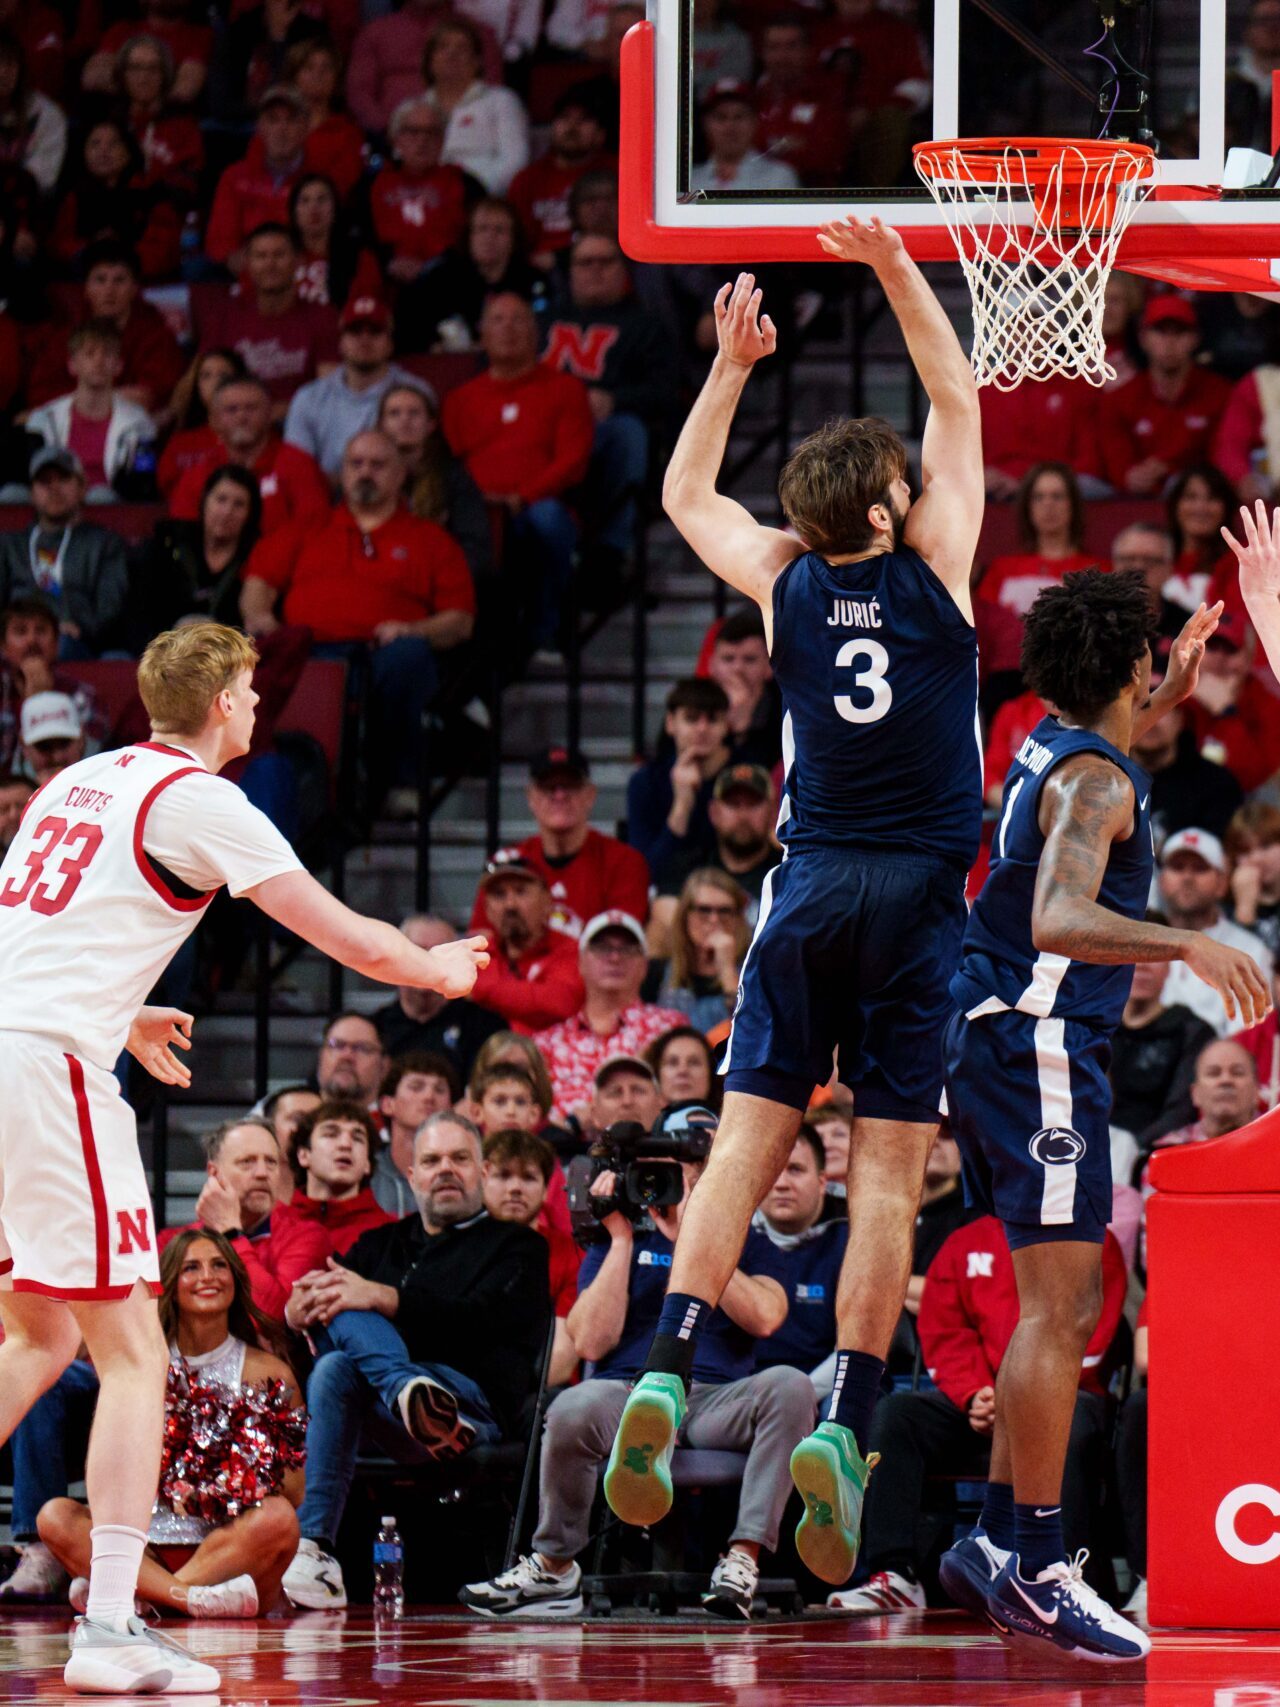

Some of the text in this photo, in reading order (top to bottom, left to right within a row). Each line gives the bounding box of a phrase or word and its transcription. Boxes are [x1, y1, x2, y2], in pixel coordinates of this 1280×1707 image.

[541, 321, 619, 379] N
[827, 596, 883, 629] JURIĆ
[833, 638, 893, 724] 3
[114, 753, 137, 768] N
[999, 776, 1025, 858] 1
[0, 815, 104, 917] 33
[116, 1208, 151, 1255] N
[966, 1251, 995, 1279] N
